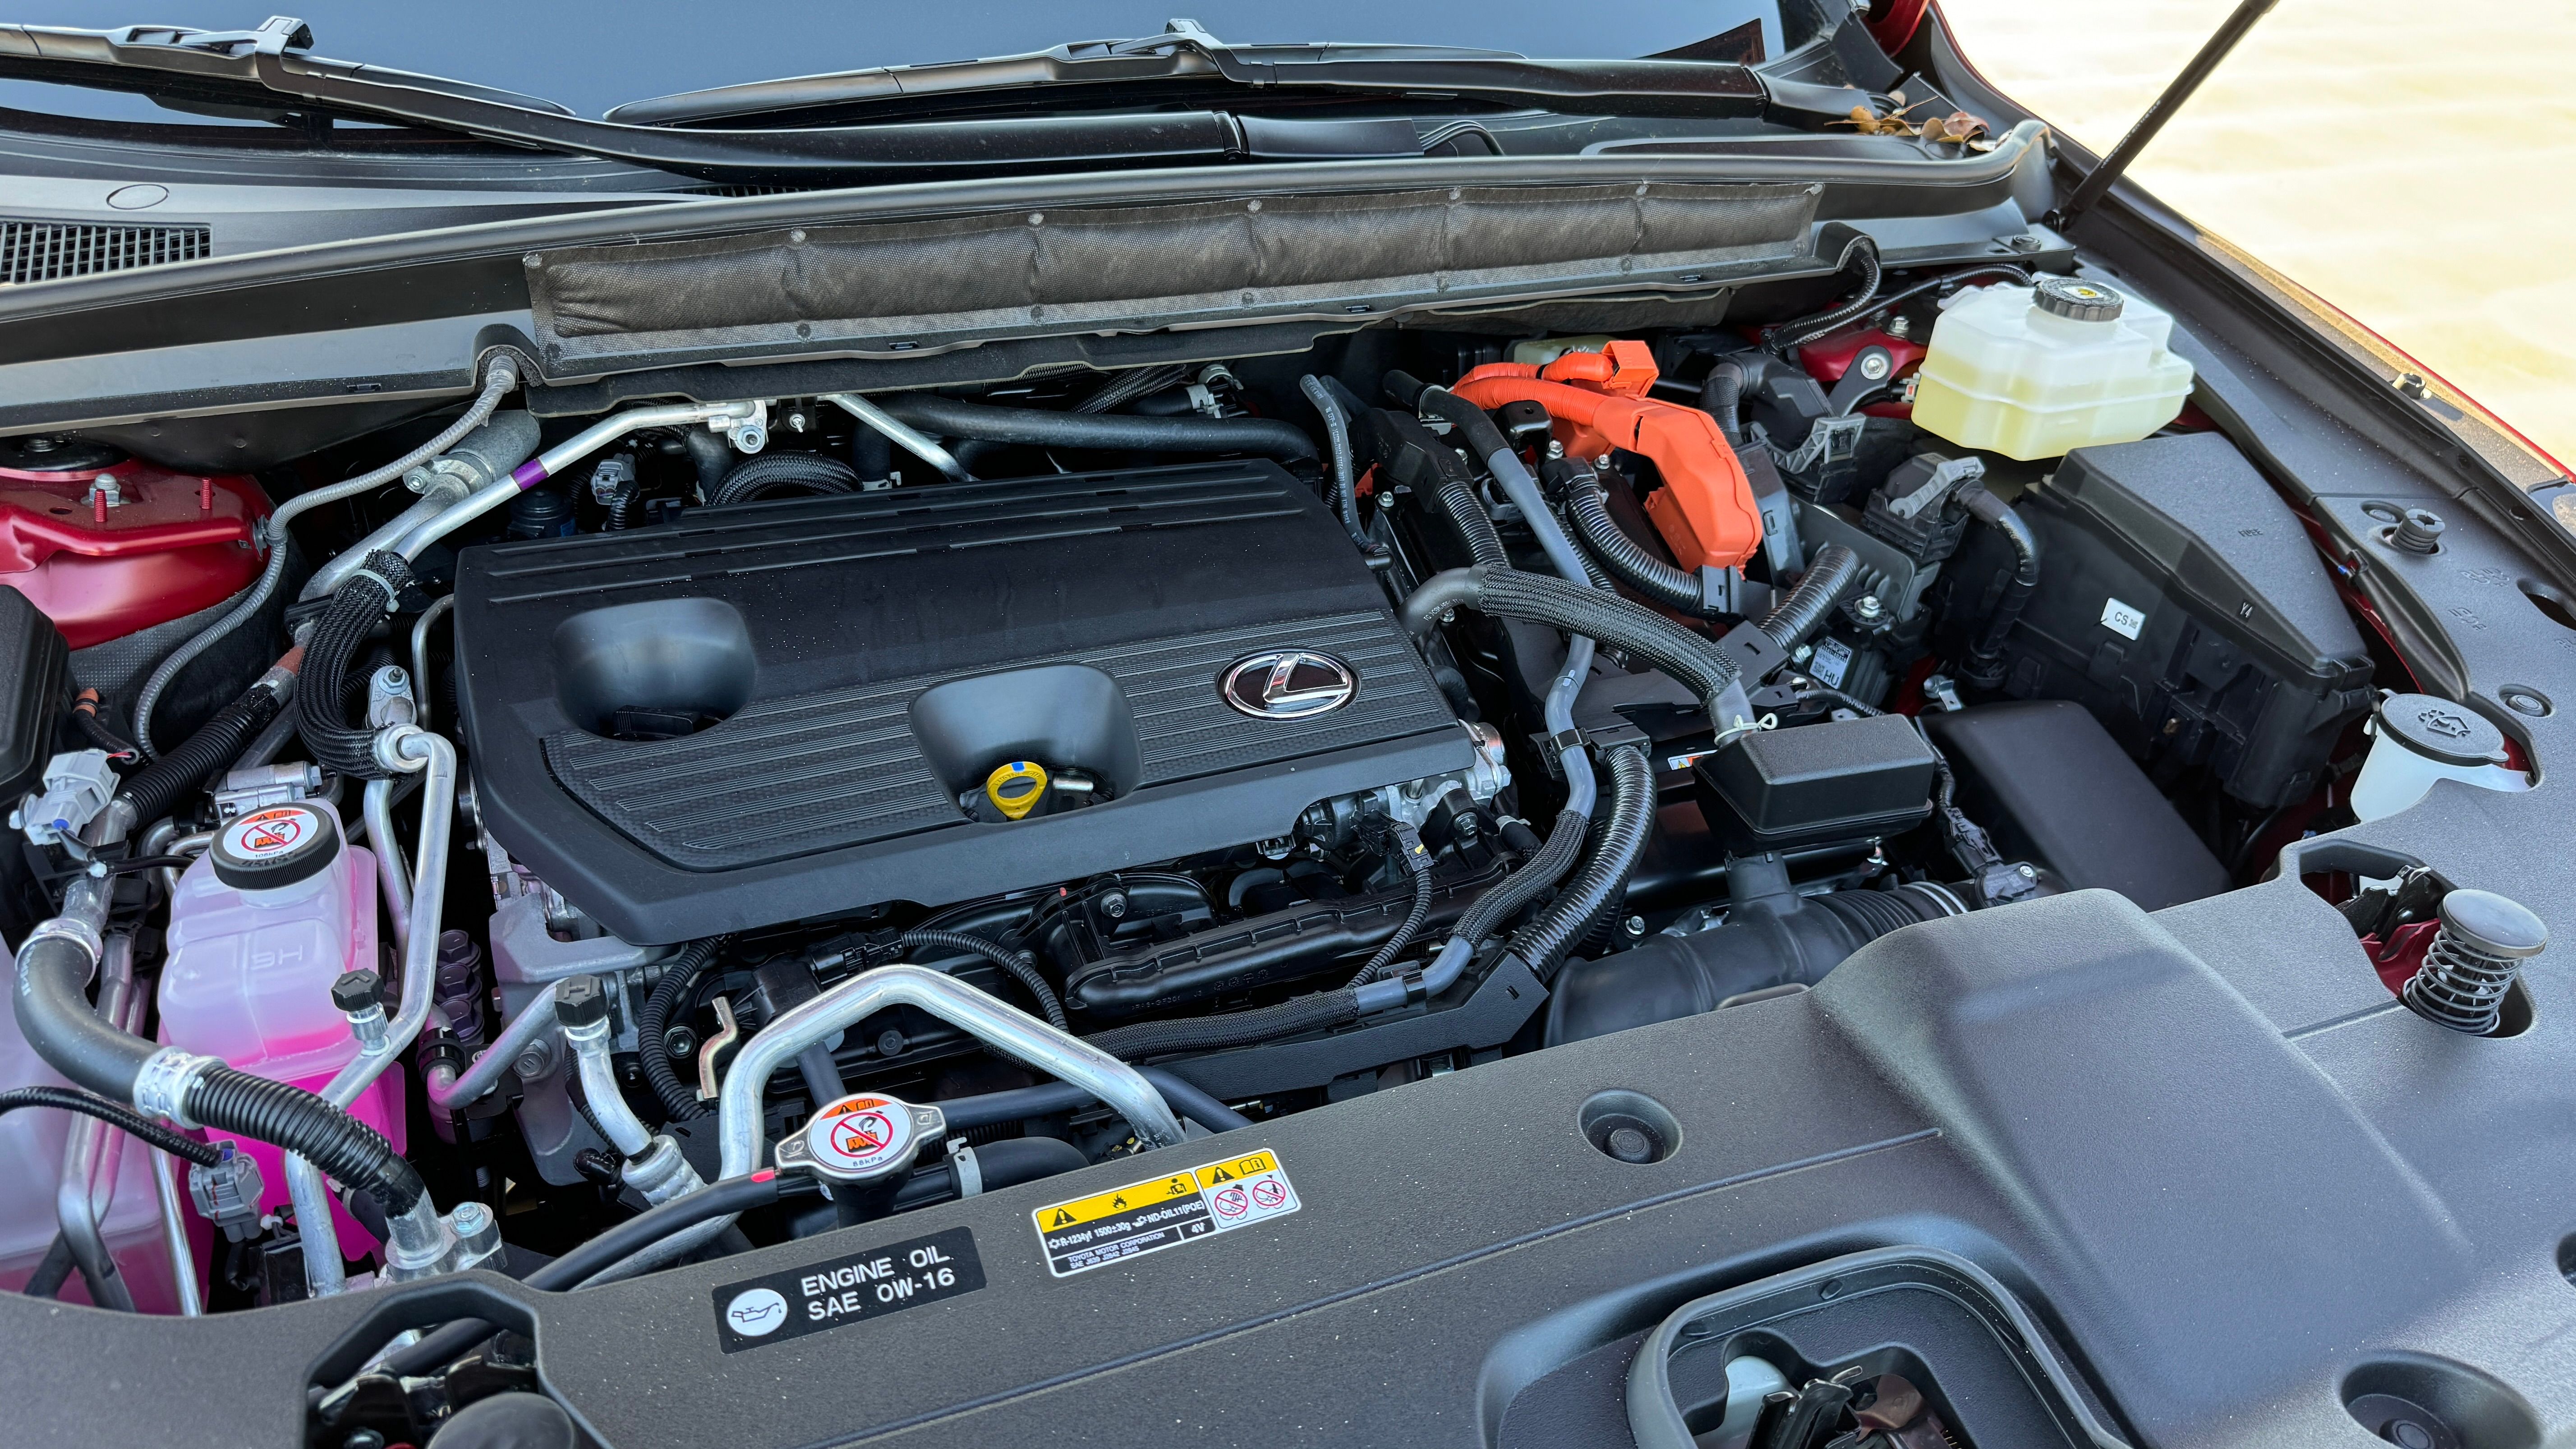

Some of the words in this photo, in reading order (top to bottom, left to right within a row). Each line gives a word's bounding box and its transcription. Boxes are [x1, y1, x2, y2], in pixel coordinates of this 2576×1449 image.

[2115, 612, 2129, 626] CS
[1823, 669, 1839, 685] HU
[564, 977, 592, 999] H
[853, 1156, 883, 1167] 88kPa
[1060, 1230, 1093, 1247] R-1234yf
[1094, 1222, 1132, 1238] 1500±30g
[1191, 1223, 1205, 1234] 4V
[1067, 1251, 1094, 1262] TOYOTA
[1096, 1244, 1118, 1256] MOTOR
[1121, 1232, 1165, 1249] CORPORATION
[801, 1257, 895, 1297] ENGINE
[909, 1246, 951, 1268] OIL
[1070, 1260, 1085, 1270] SAE
[808, 1291, 861, 1320] SAE
